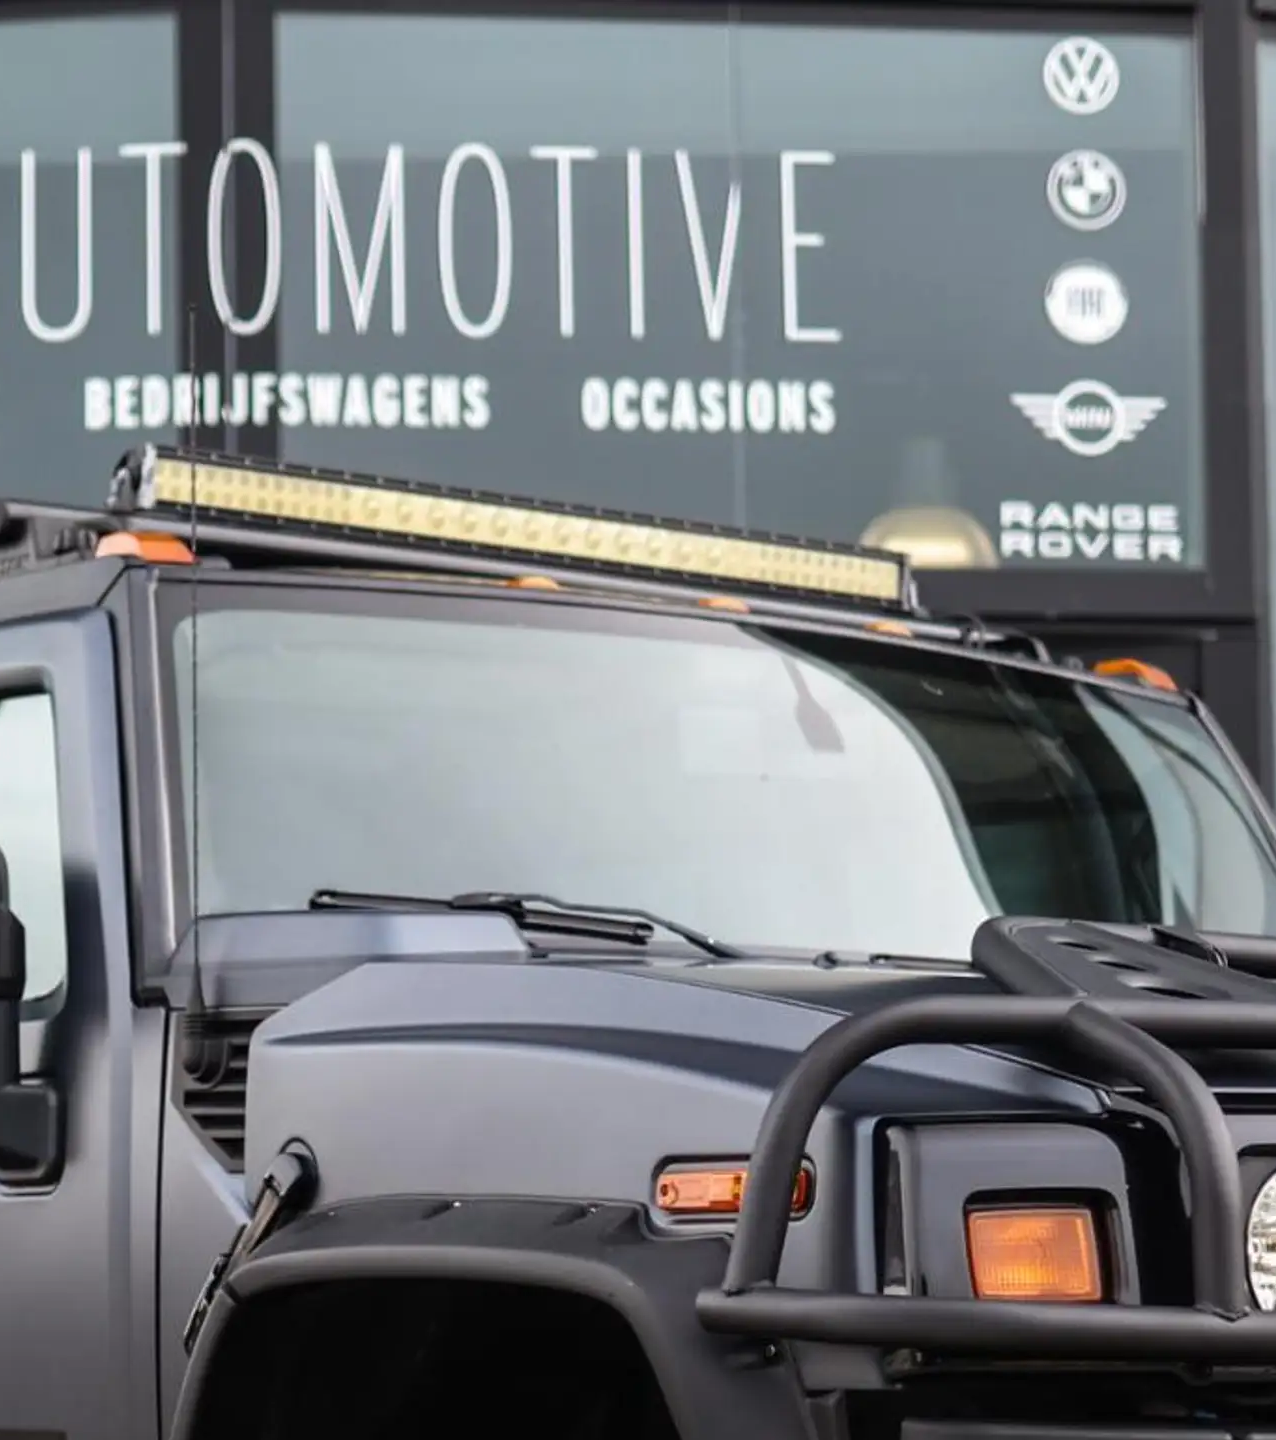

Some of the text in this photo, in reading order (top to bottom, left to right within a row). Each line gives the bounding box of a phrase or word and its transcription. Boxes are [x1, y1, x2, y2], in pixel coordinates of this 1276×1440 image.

[84, 372, 490, 430] BEDRIJFSWAGENS
[581, 377, 835, 434] OCCASIONS
[999, 500, 1179, 530] RANGE
[1000, 532, 1183, 561] ROVER
